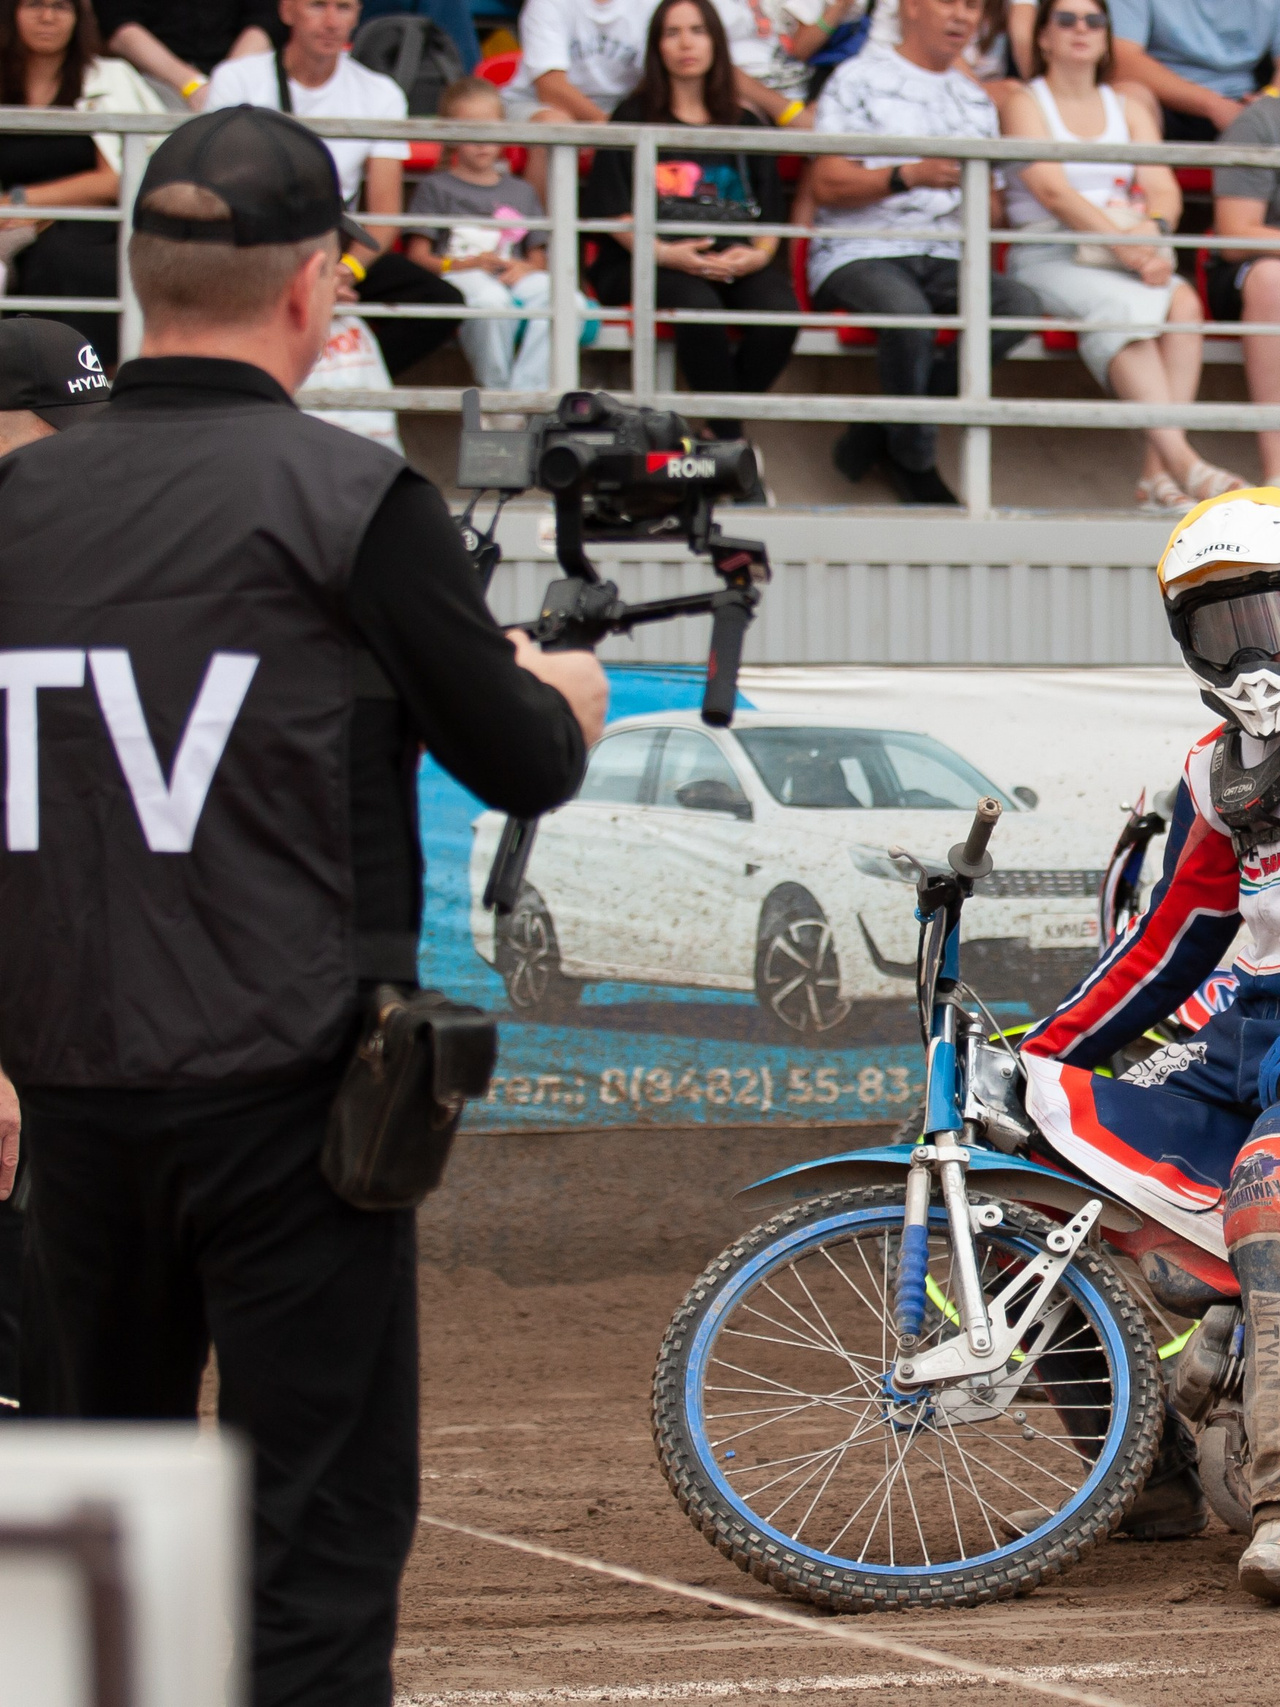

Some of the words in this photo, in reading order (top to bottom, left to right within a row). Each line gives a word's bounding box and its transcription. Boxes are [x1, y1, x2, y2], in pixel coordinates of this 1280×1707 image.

[68, 375, 108, 394] HYUN
[1195, 543, 1241, 559] SHOEI
[0, 649, 260, 853] TV
[1223, 781, 1254, 798] ORTEMA
[600, 1067, 773, 1111] 8(8482)
[786, 1067, 925, 1104] 55-83-
